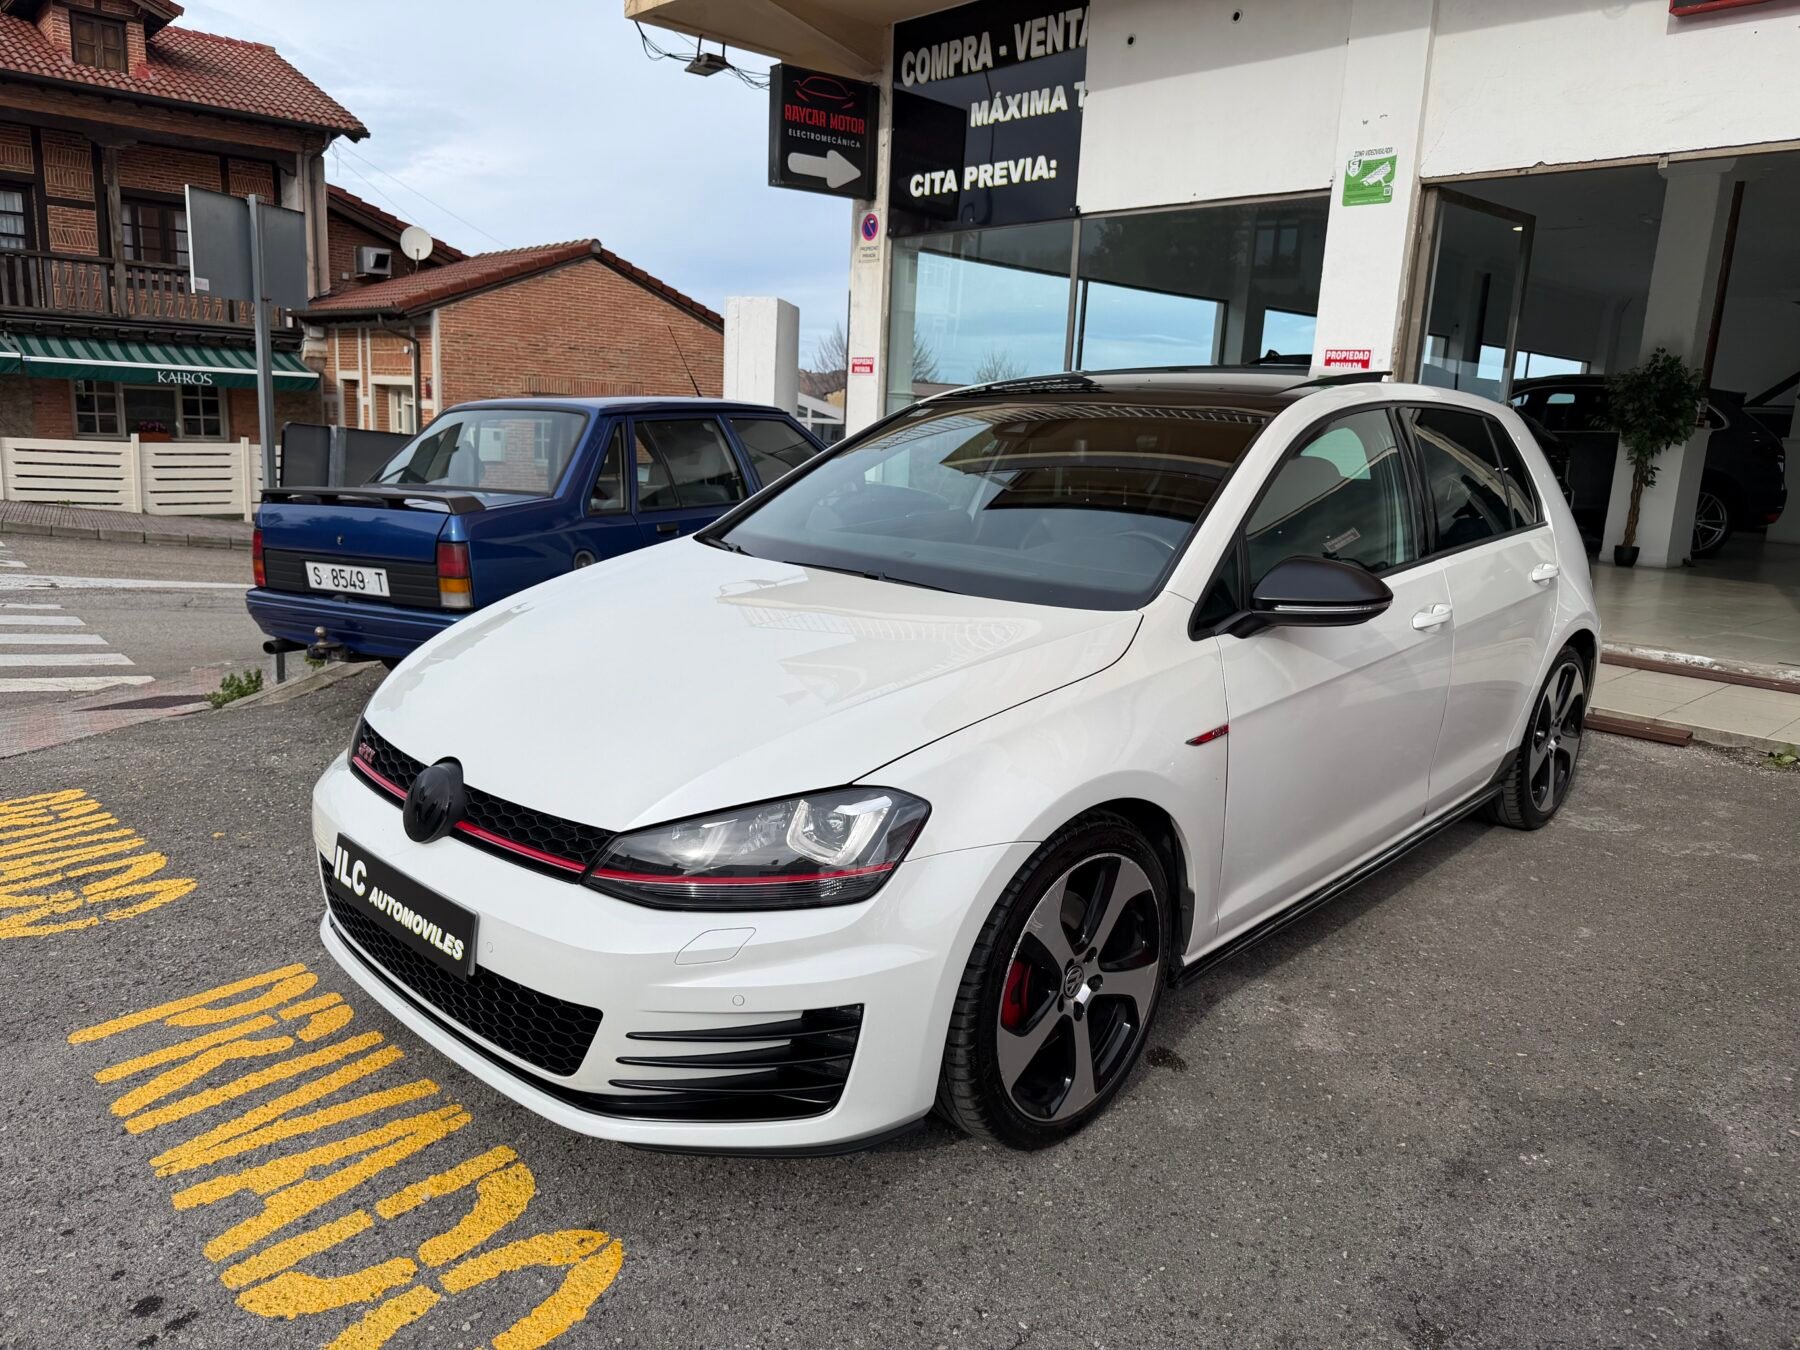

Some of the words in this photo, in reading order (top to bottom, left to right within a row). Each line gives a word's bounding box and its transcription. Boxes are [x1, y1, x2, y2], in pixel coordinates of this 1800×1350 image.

[902, 31, 993, 87] COMPRA
[785, 104, 826, 127] RAYCAR
[829, 113, 864, 134] MOTOR
[970, 85, 1068, 127] MÁXIMA
[788, 128, 861, 148] ELECTROMECÁNICA
[910, 169, 958, 197] CITA
[963, 155, 1057, 190] PREVIA:
[1326, 350, 1370, 360] PROPIEDAD
[313, 566, 322, 586] S
[331, 568, 366, 591] 8549
[374, 572, 383, 593] T
[333, 845, 368, 897] ILC
[368, 886, 465, 961] AUTOMOVILES
